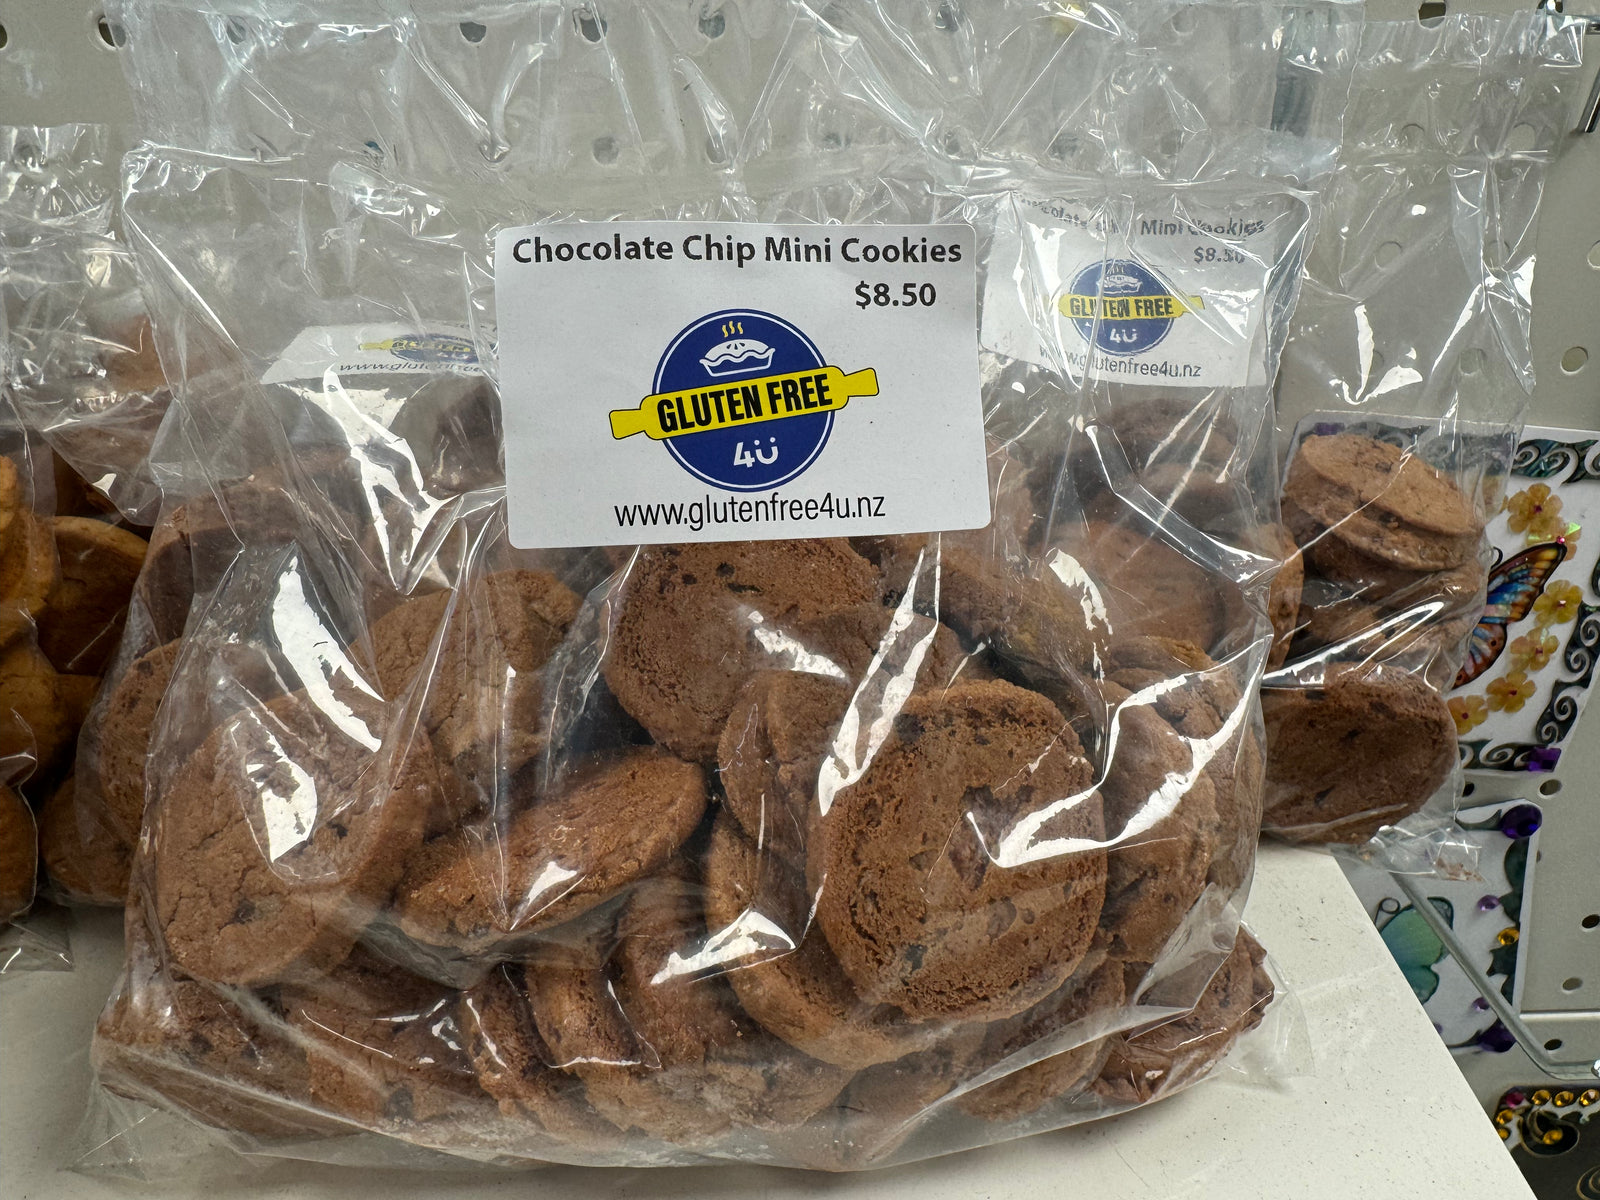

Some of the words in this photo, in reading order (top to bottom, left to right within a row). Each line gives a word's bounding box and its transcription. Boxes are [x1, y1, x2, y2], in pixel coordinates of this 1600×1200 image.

[1140, 218, 1183, 236] Mini
[512, 234, 674, 263] Chocolate
[682, 235, 756, 268] Chip
[765, 237, 832, 263] Mini
[841, 237, 962, 263] Cookies
[1193, 246, 1246, 264] $8.50
[854, 281, 937, 309] $8.50
[1134, 297, 1174, 317] FREE
[656, 384, 762, 433] GLUTEN
[768, 372, 833, 417] FREE
[614, 492, 886, 531] www.glutenfree4u.nz
